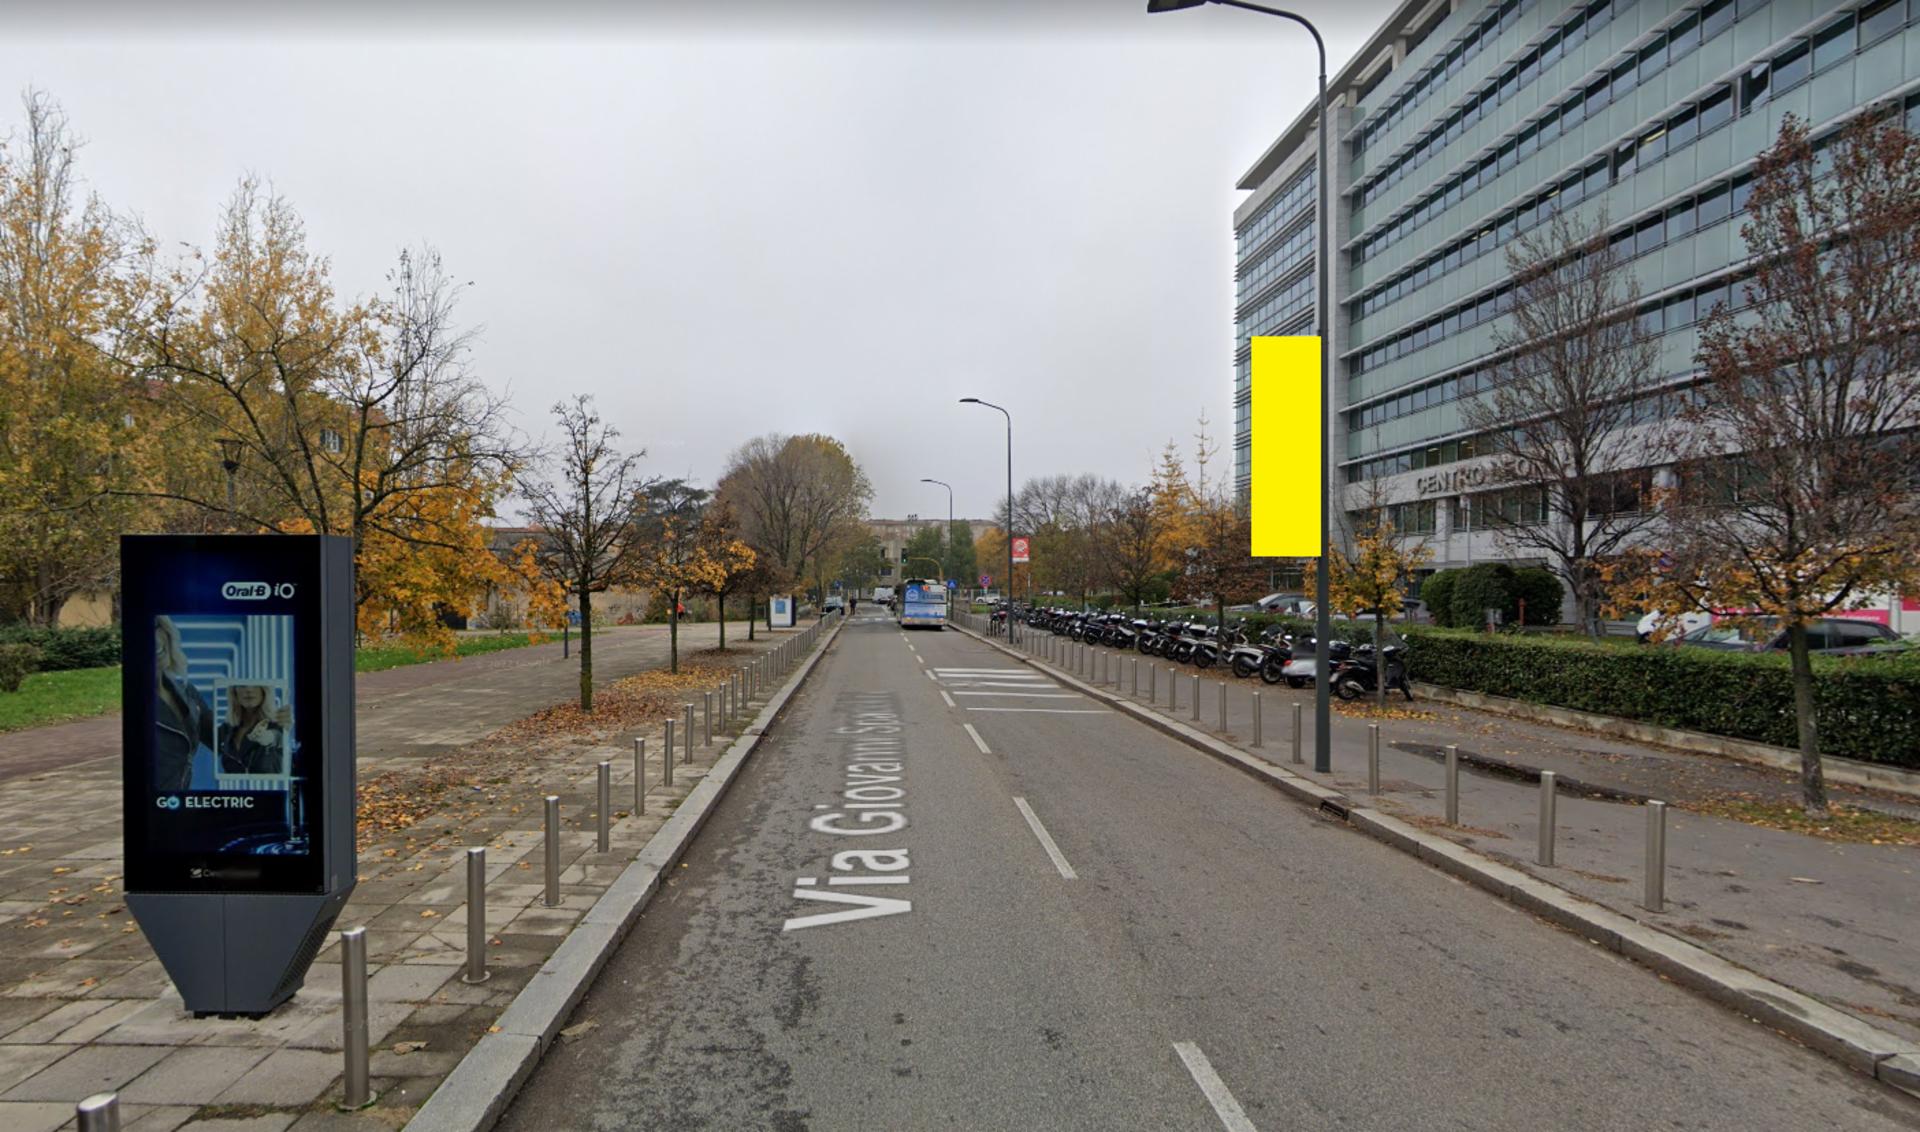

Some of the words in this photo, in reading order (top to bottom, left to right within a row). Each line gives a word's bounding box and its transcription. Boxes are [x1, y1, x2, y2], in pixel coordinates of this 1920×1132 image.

[1416, 464, 1486, 494] CENTRO
[225, 584, 267, 598] Oral-B
[156, 795, 180, 810] GO
[185, 796, 254, 809] ELECTRIC
